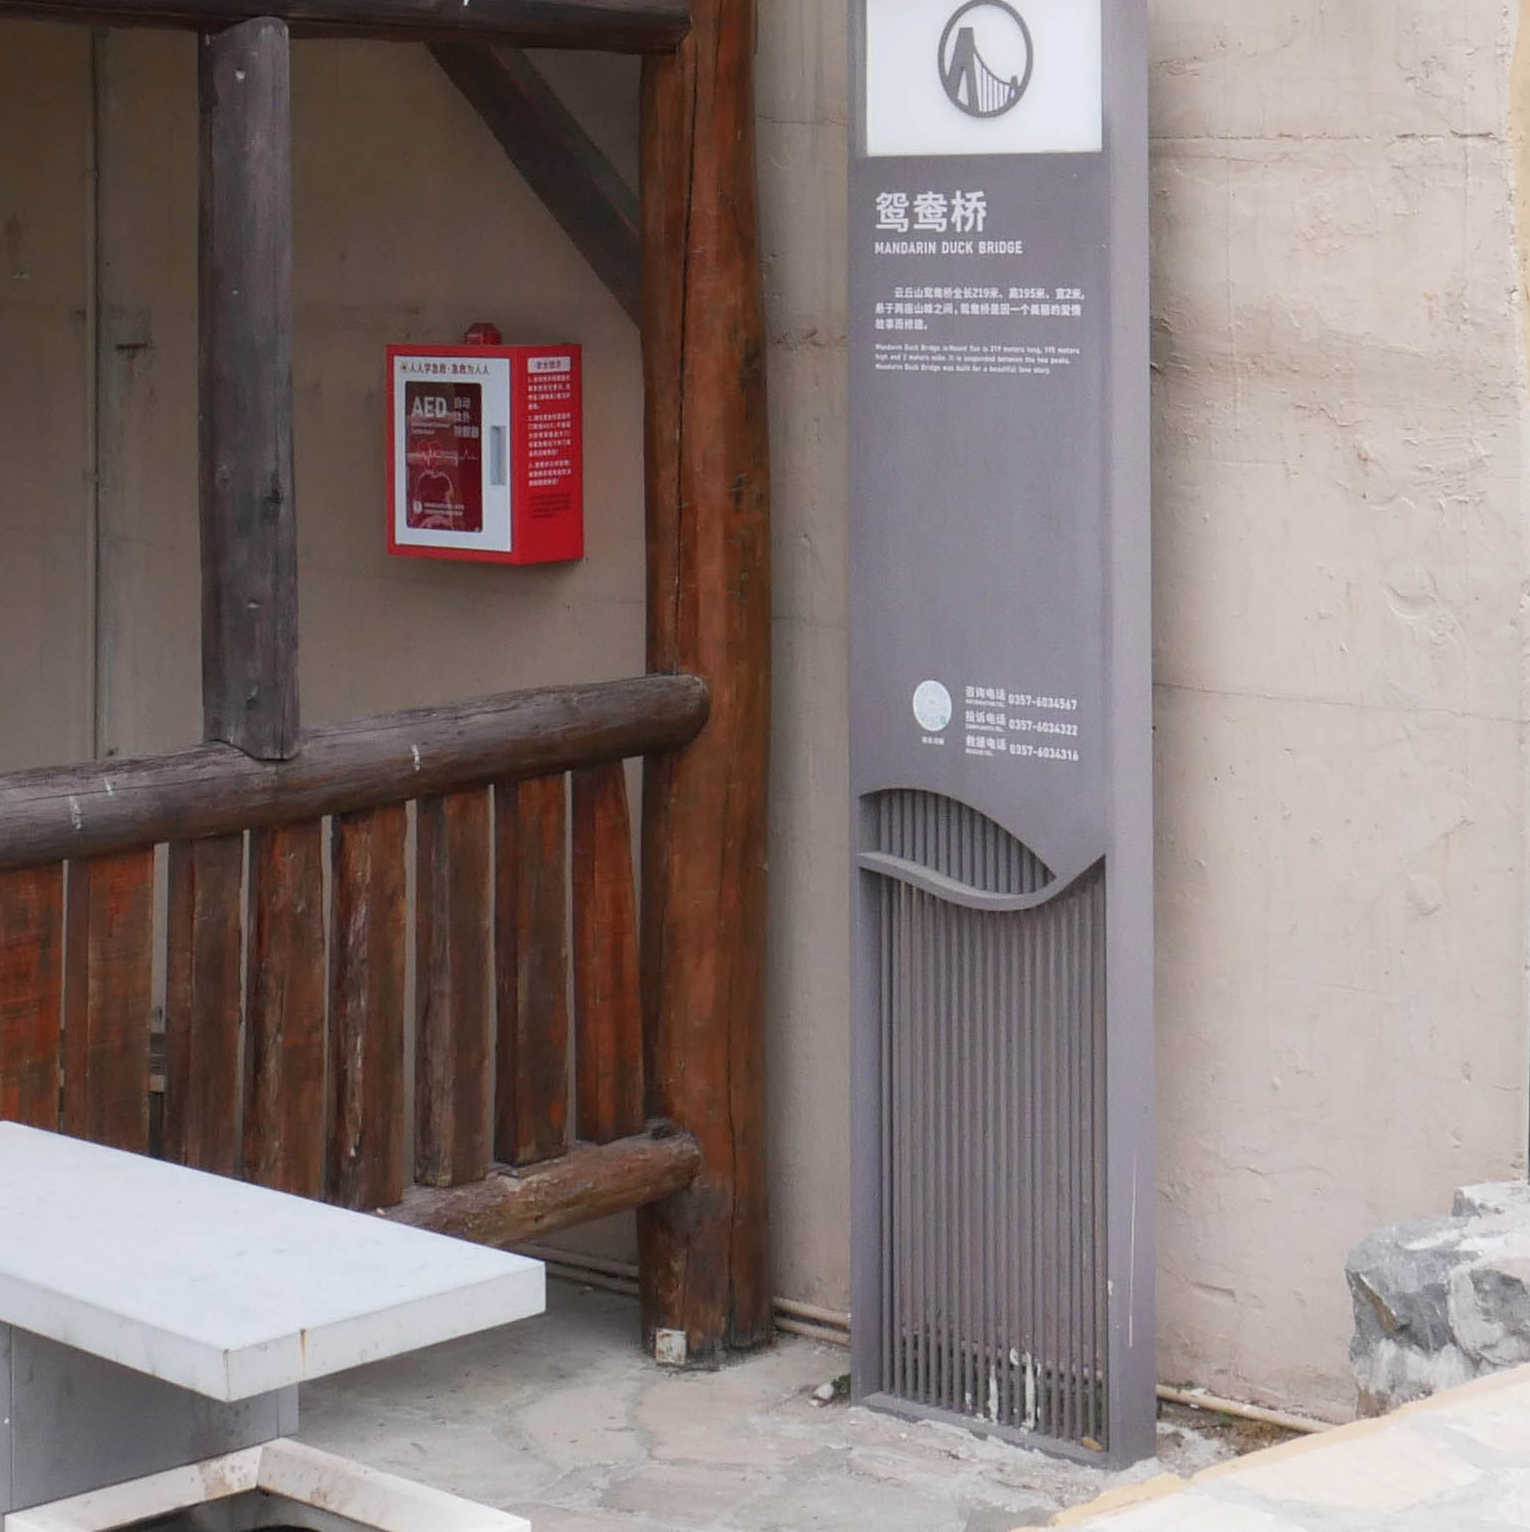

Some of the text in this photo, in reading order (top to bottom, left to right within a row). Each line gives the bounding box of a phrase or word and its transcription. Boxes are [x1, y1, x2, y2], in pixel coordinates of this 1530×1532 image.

[875, 190, 987, 232] 鸳鸯桥
[875, 241, 1023, 254] MANDARIN DUCK BRIDGE
[411, 396, 447, 418] AED
[1008, 694, 1078, 711] 0357-6034567
[1008, 719, 1078, 736] 0357-6034322
[1009, 743, 1079, 761] 0357-6034316
